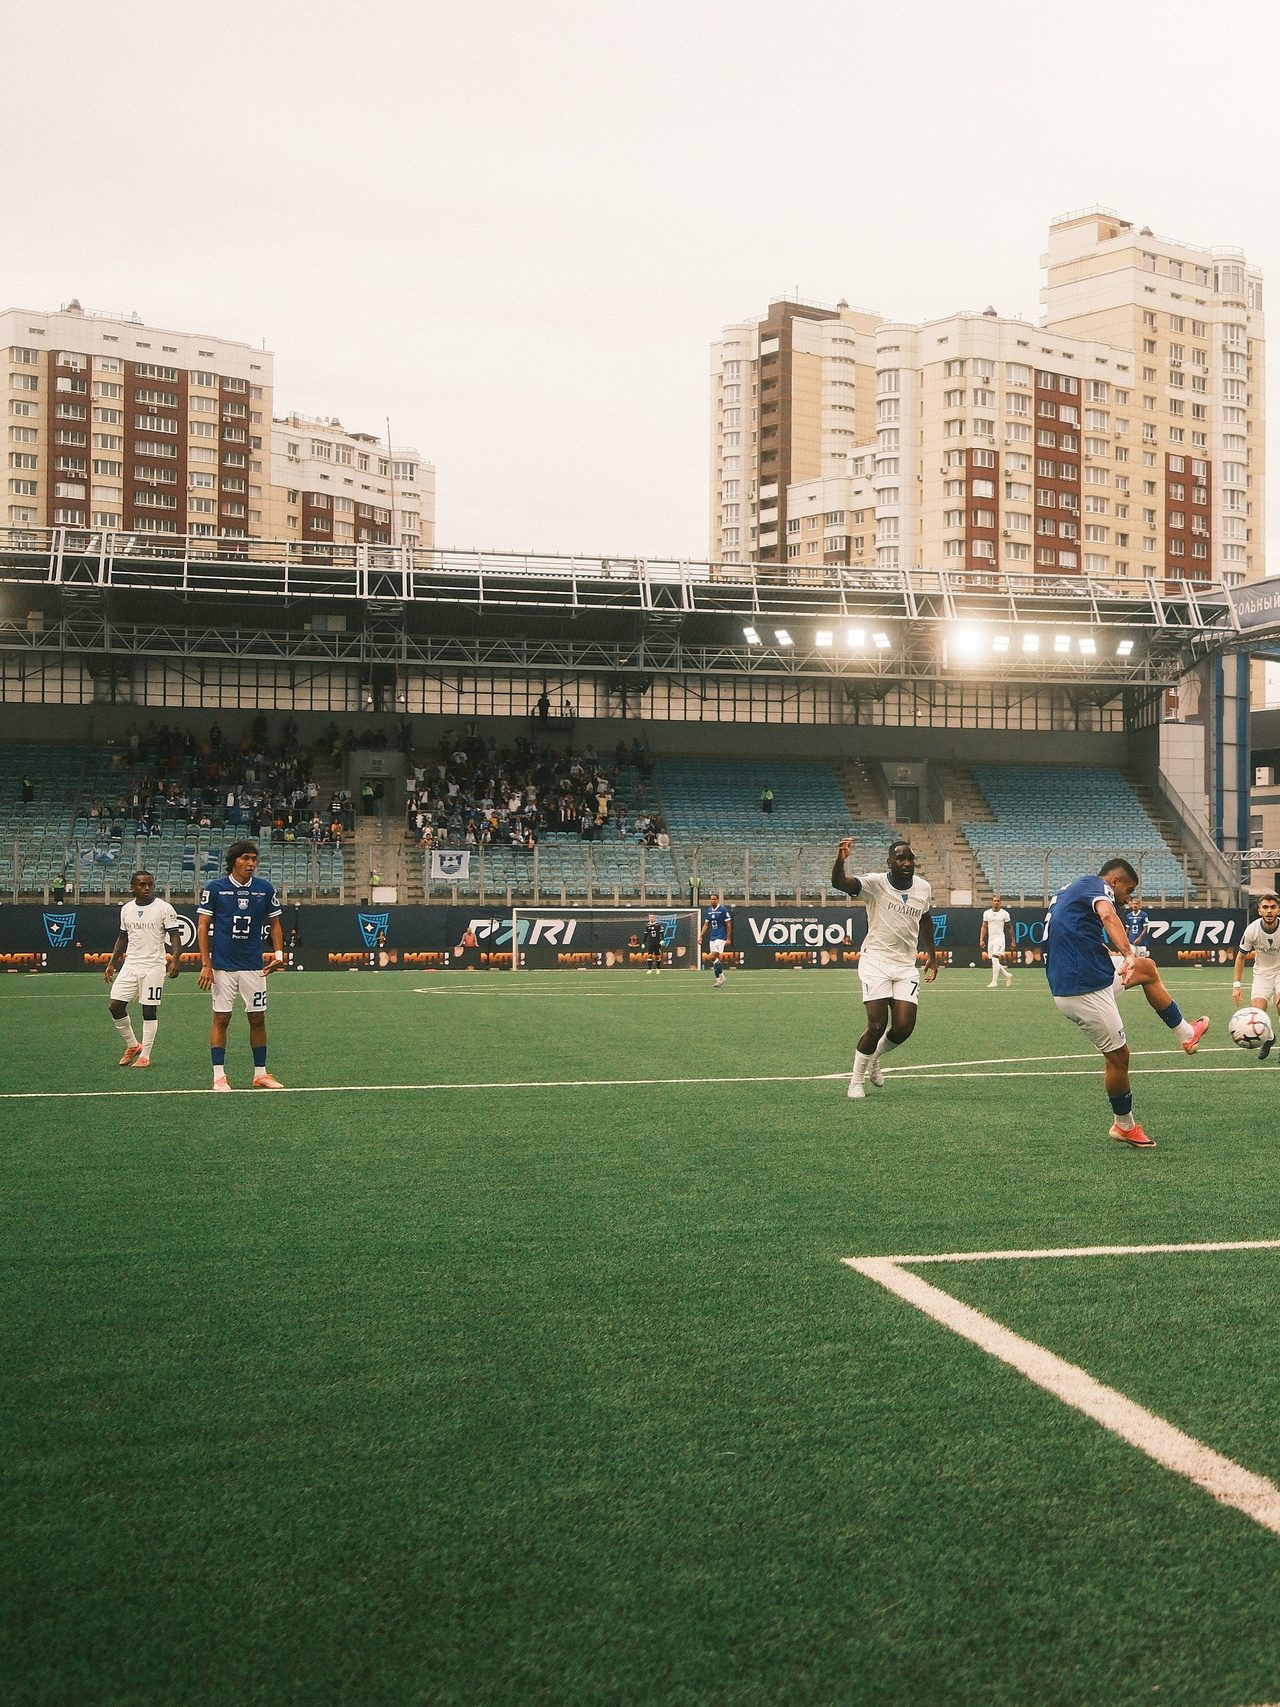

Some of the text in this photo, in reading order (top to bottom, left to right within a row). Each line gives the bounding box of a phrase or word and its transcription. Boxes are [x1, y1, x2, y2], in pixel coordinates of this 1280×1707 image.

[467, 919, 577, 945] PARI
[748, 918, 852, 946] Vorgol
[1149, 920, 1235, 944] PARI
[147, 986, 163, 1001] 10
[253, 991, 267, 1007] 22
[910, 981, 919, 997] 7
